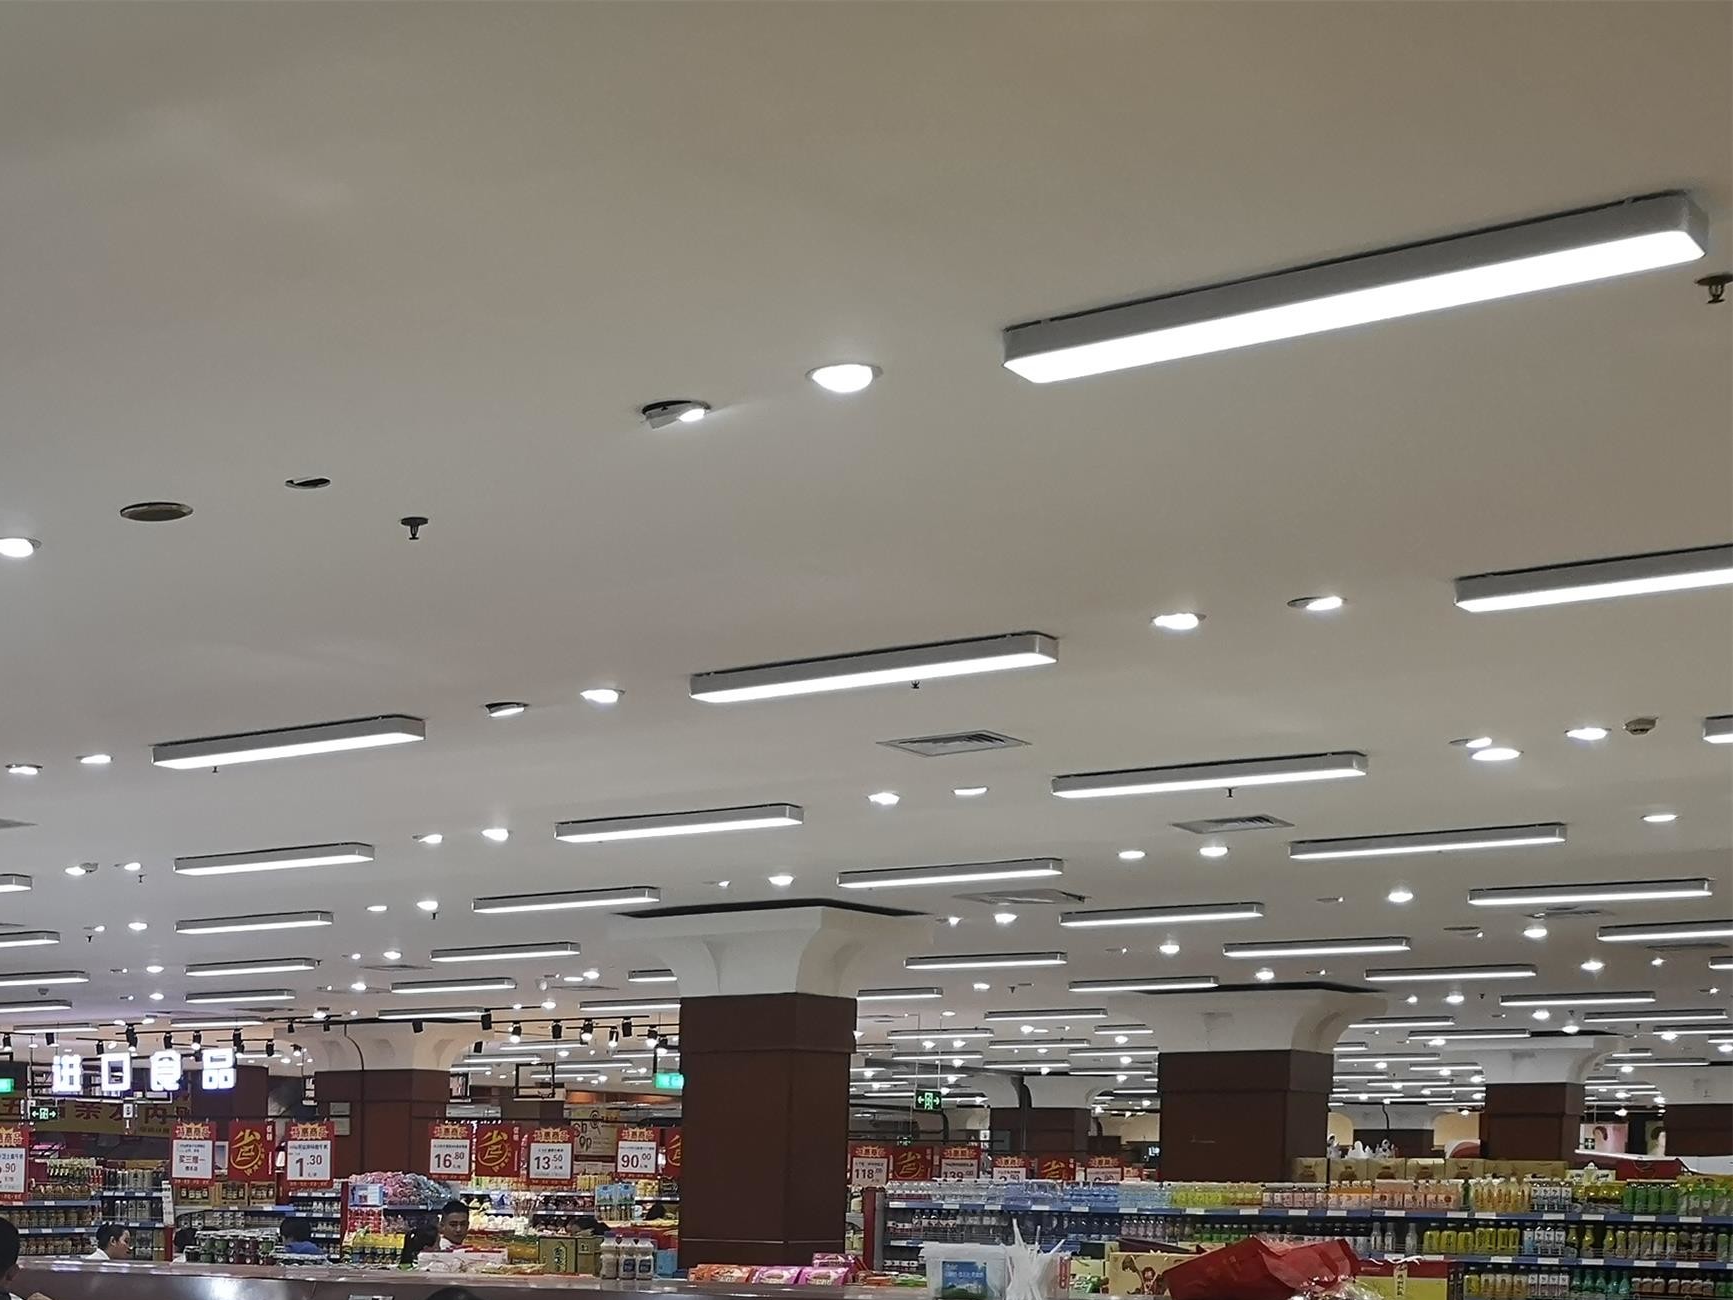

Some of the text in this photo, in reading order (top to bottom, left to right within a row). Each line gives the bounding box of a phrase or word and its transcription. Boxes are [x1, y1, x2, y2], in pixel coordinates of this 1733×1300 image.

[53, 1048, 236, 1093] 进口食品
[295, 1154, 323, 1178] 1.30
[434, 1151, 465, 1168] 16.80
[534, 1153, 563, 1170] 13.50
[620, 1152, 652, 1169] 90.00
